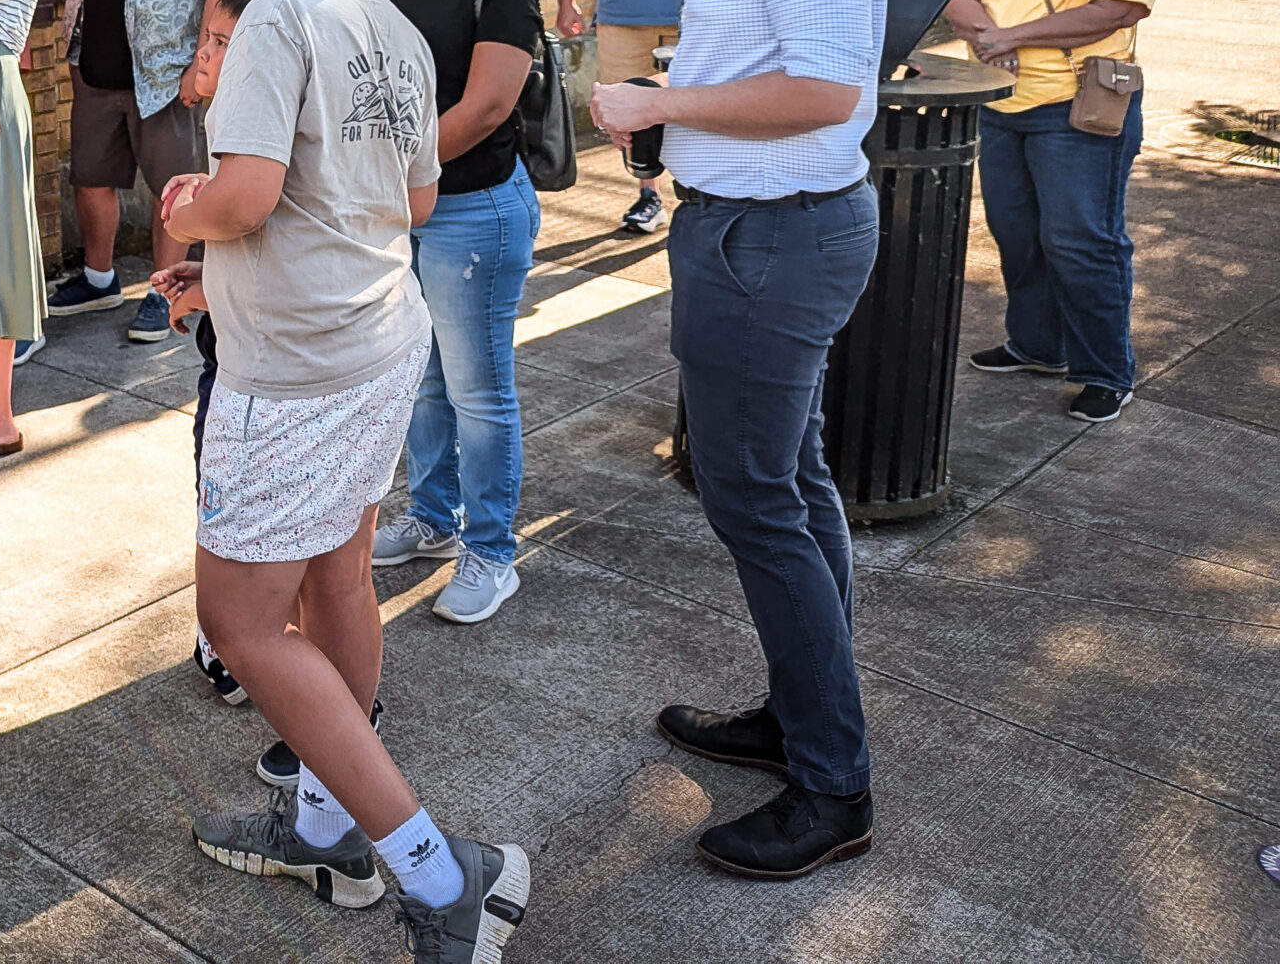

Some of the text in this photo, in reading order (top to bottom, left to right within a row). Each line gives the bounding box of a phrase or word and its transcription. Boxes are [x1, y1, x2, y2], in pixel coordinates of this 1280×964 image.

[341, 126, 362, 143] FOR
[368, 123, 392, 139] THE
[410, 842, 440, 868] adidas
